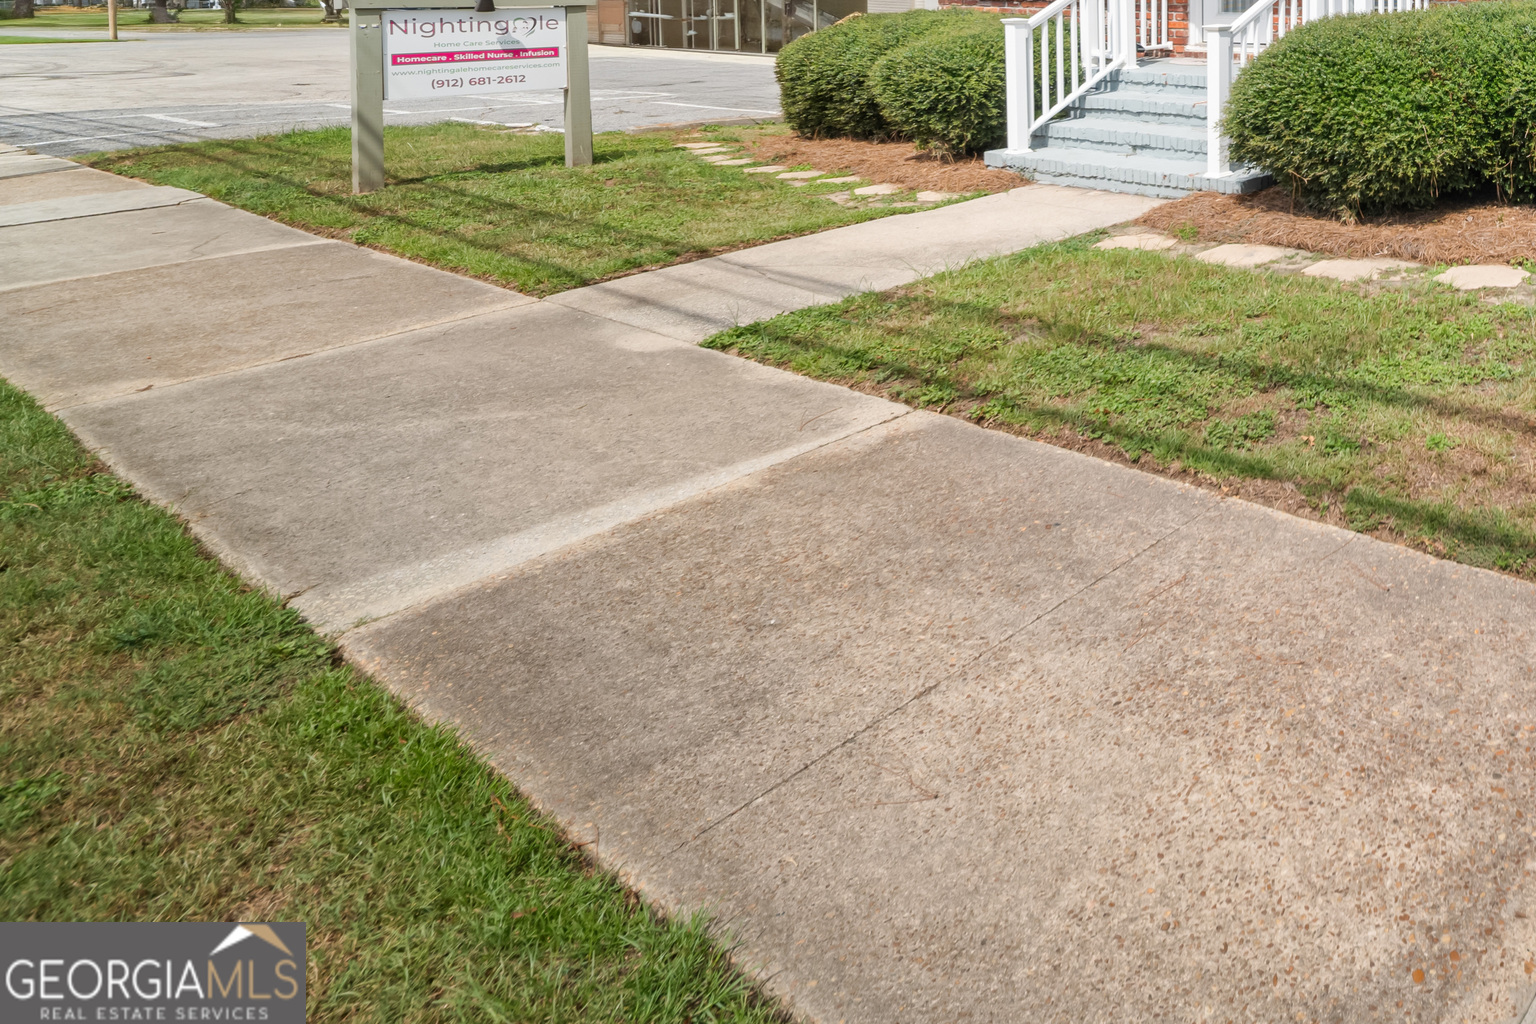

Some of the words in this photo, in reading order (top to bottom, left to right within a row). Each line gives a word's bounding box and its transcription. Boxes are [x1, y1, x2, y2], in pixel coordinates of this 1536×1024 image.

[396, 55, 447, 64] Homecare
[453, 53, 485, 61] Skilled
[487, 51, 514, 59] Nurse
[520, 49, 555, 57] Infusion
[391, 62, 560, 76] www.nightingalehomecareservices.com
[431, 77, 464, 90] (912)
[468, 74, 526, 86] 681-2612
